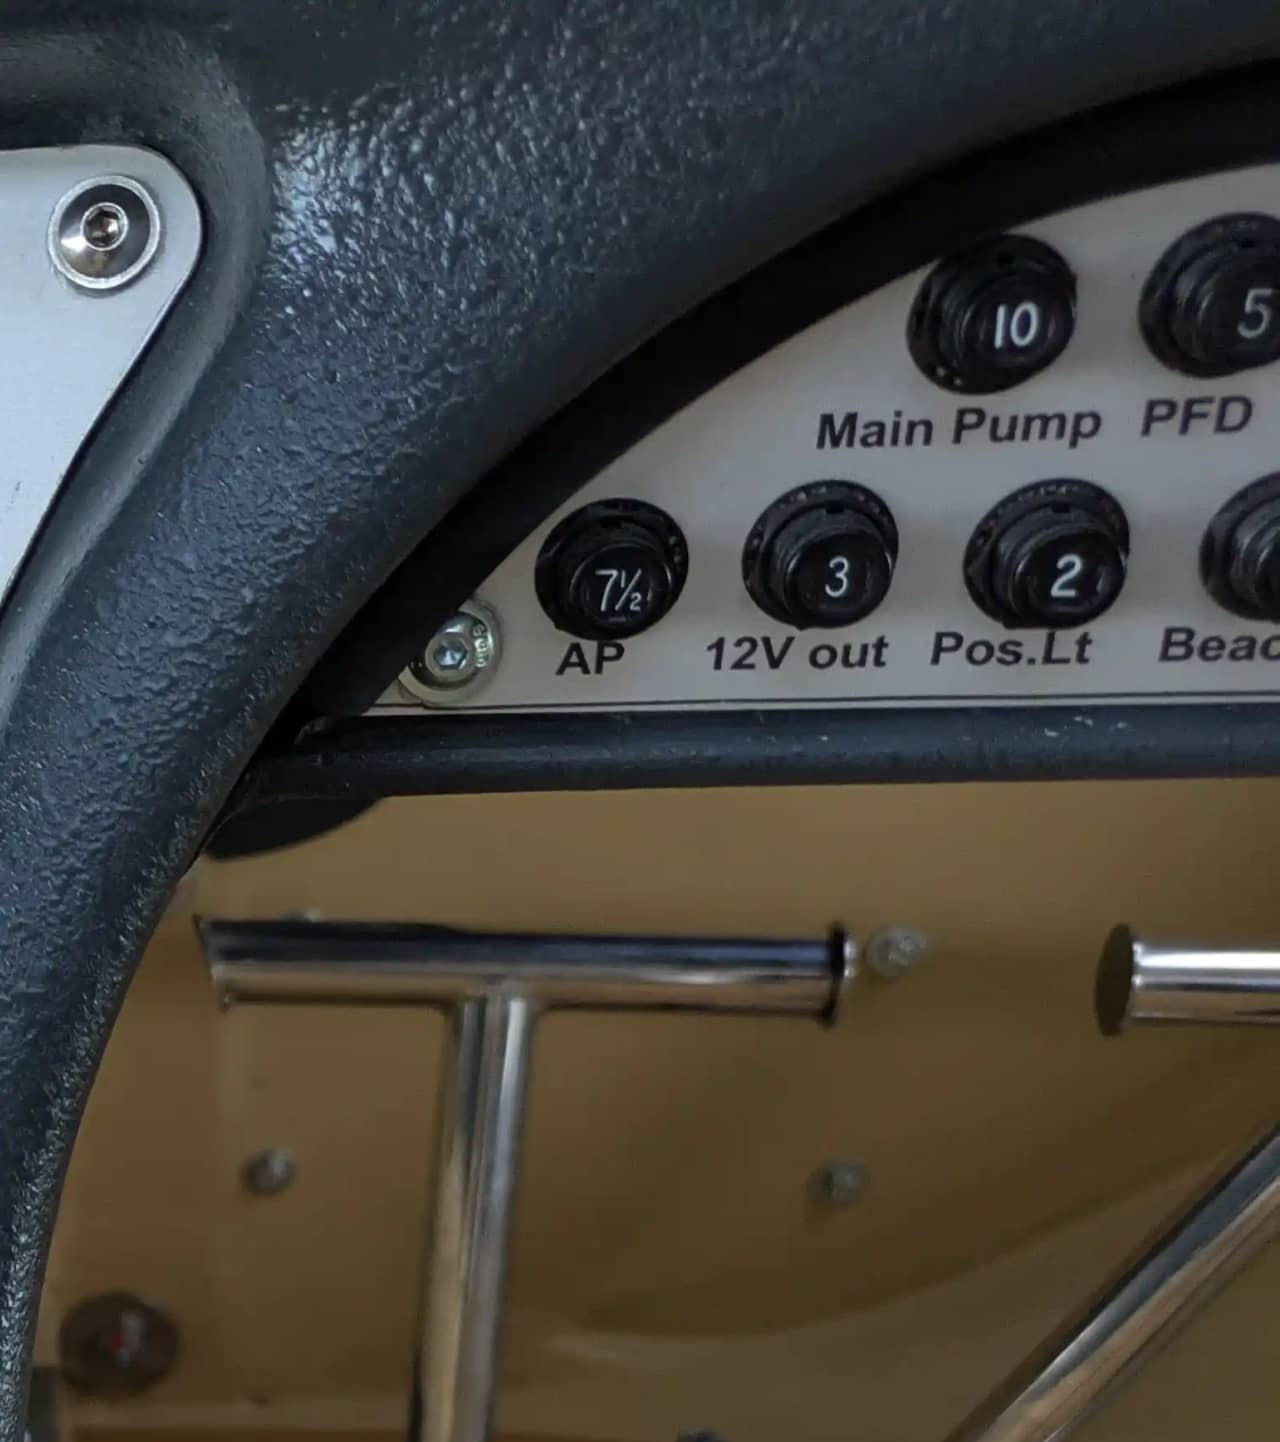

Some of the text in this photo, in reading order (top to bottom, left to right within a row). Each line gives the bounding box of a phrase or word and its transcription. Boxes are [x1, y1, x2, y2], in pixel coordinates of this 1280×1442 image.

[993, 301, 1039, 349] 10
[1237, 289, 1274, 339] 5
[816, 405, 1103, 450] Main Pump
[1141, 395, 1253, 437] PFD
[825, 557, 849, 598] 3
[1050, 554, 1082, 598] 2
[556, 641, 624, 676] AP
[706, 635, 889, 671] 12V out
[930, 630, 1093, 668] Pos.Lt
